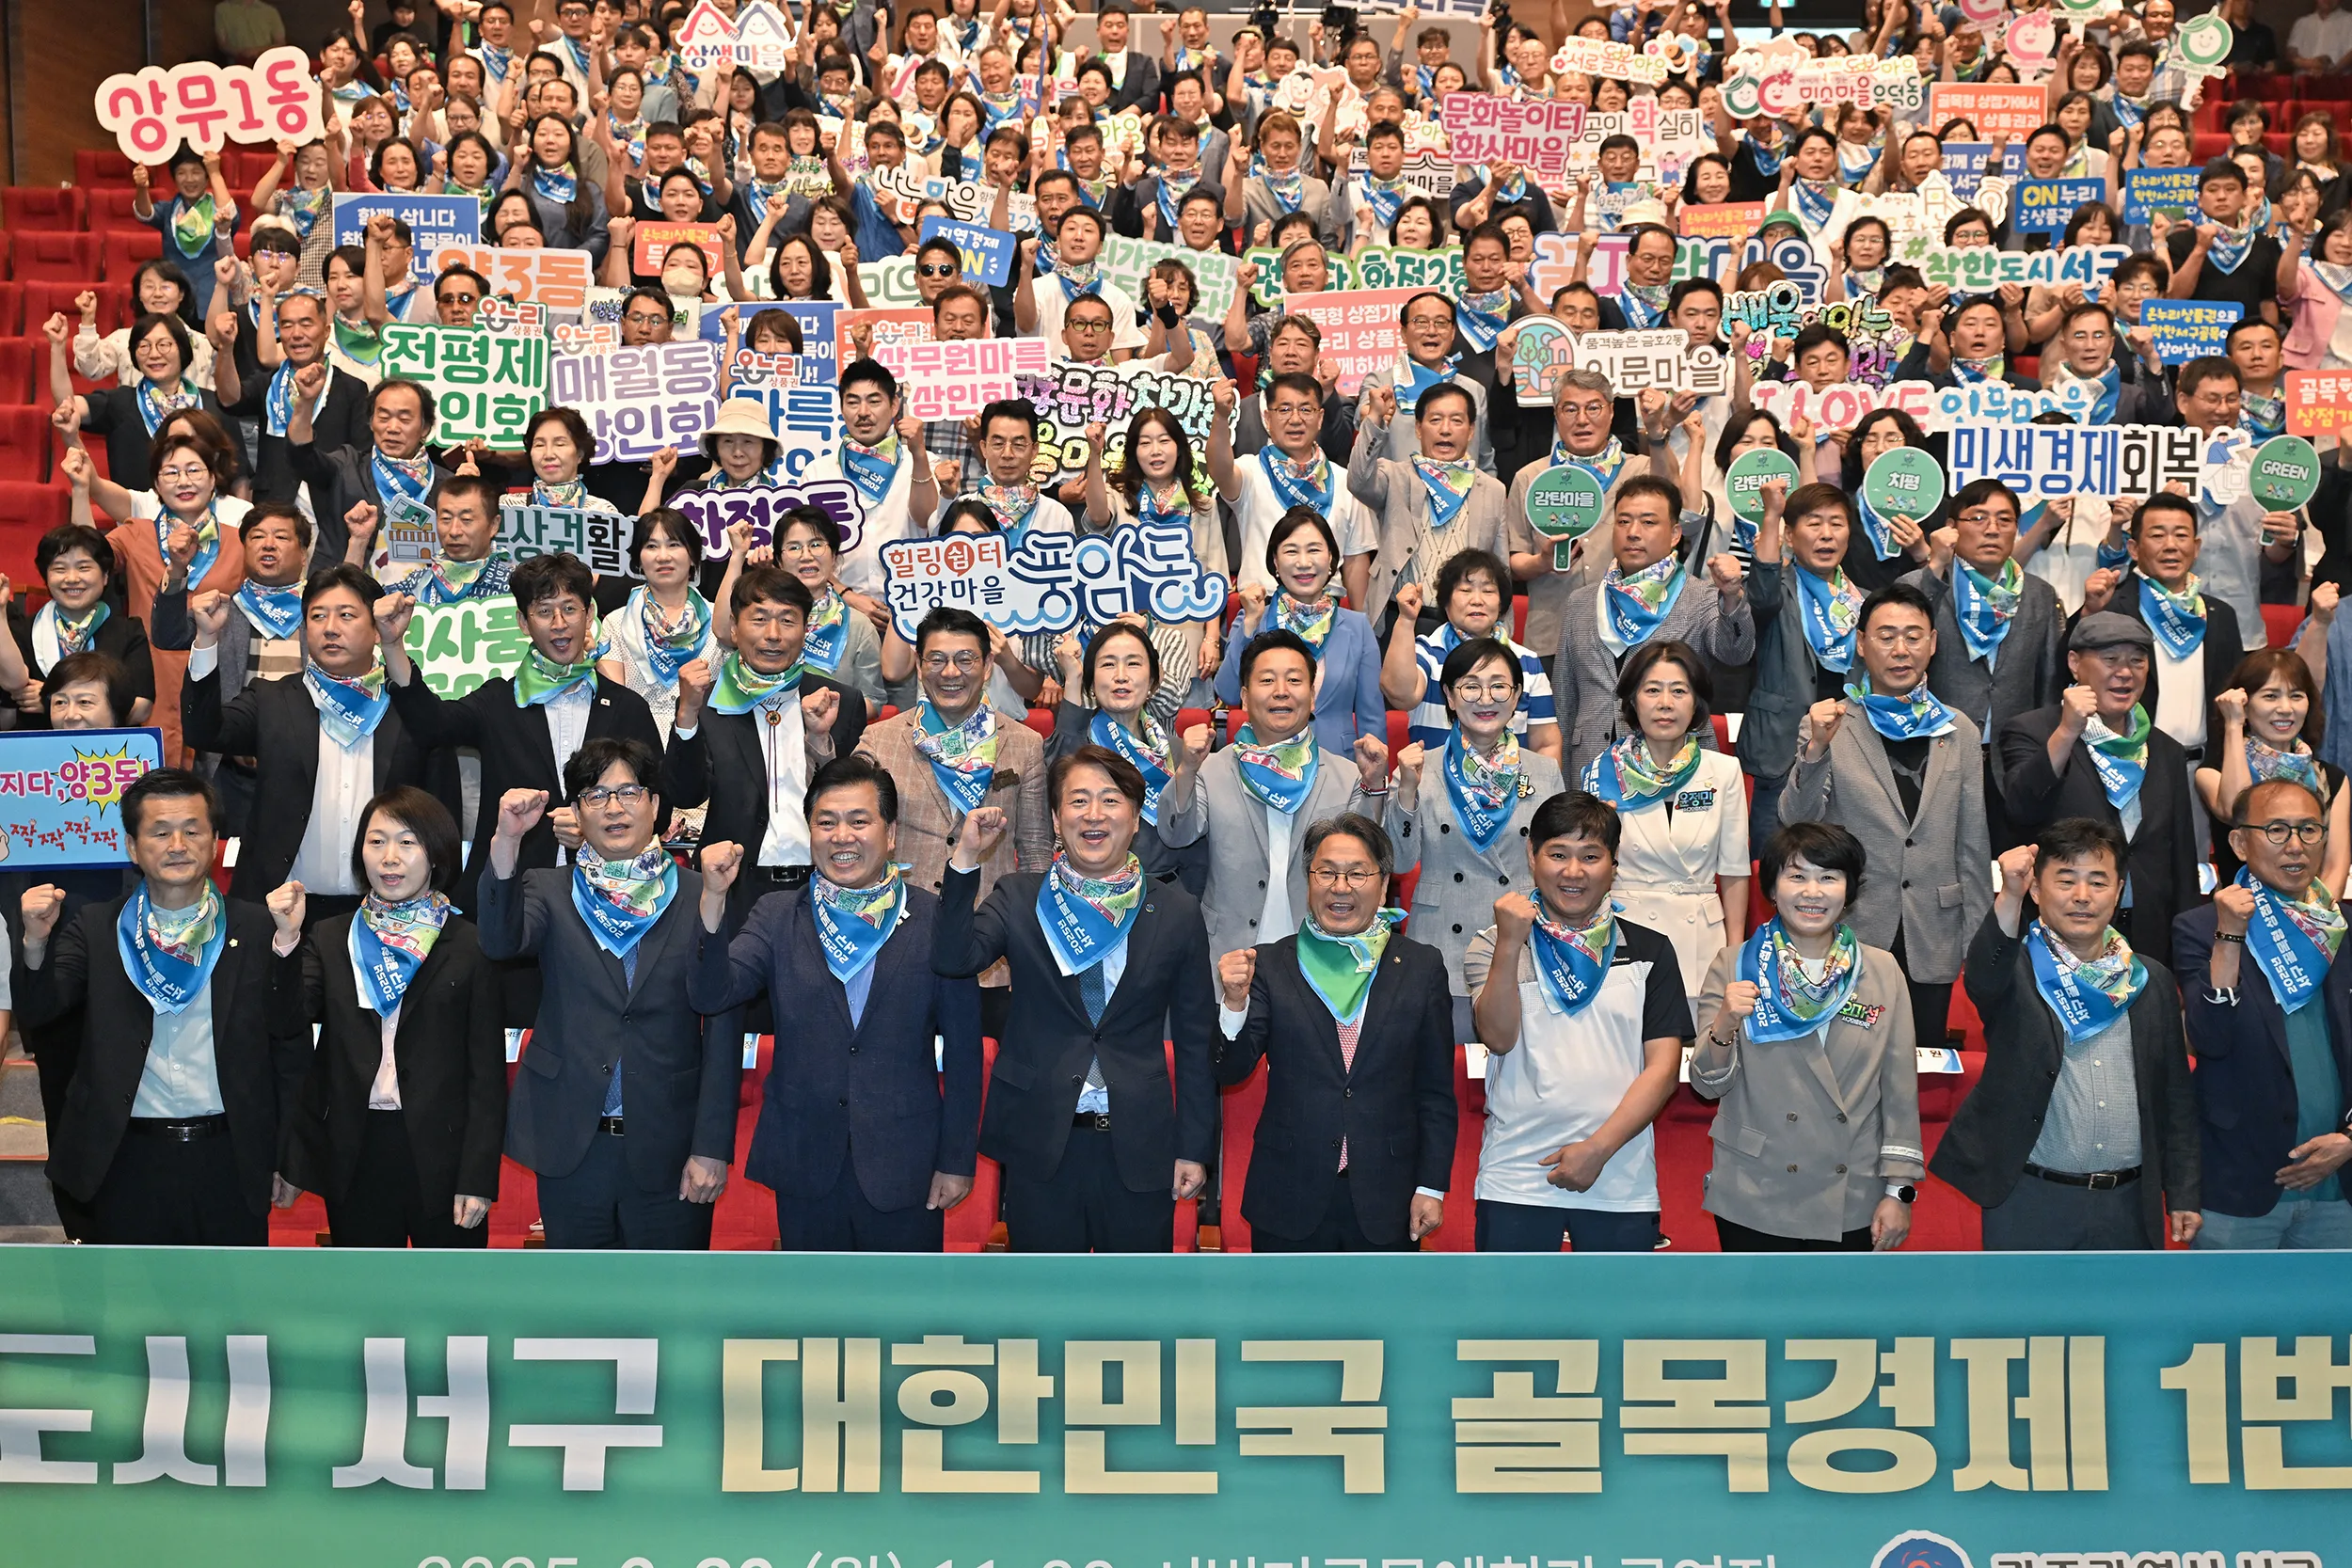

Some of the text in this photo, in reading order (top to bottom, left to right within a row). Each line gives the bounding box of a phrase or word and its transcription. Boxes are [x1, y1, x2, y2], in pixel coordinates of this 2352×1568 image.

[685, 44, 783, 68] 상생마을
[109, 59, 309, 152] 상무1동
[1443, 96, 1582, 139] 문화놀이터
[1454, 131, 1565, 170] 화사마을
[400, 209, 456, 228] 삽니다
[937, 224, 1000, 249] 지역경제
[476, 298, 544, 333] 온누리
[511, 325, 543, 337] 상품권
[551, 324, 618, 356] 온누리
[587, 342, 618, 356] 상품권
[874, 319, 921, 346] 온누리
[1585, 333, 1684, 351] 품격높은 금호2동
[386, 330, 543, 388] 전평제
[553, 346, 714, 404] 매월동
[733, 351, 801, 385] 온누리
[877, 341, 1047, 379] 상무원마륵
[1586, 351, 1722, 390] 인문마을
[769, 376, 799, 388] 상품권
[437, 391, 541, 442] 인회
[1790, 387, 1931, 432] LOVE
[1952, 426, 2200, 497] 민생경제회복
[2260, 458, 2310, 482] GREEN
[1887, 471, 1921, 491] 치평
[1534, 490, 1596, 508] 감탄마을
[894, 575, 1006, 611] 건강마을
[1677, 790, 1715, 808] 윤정민
[818, 930, 850, 964] 2025년
[834, 935, 860, 956] 서구
[1057, 919, 1084, 956] 2025년
[1072, 923, 1096, 951] 서구
[2270, 927, 2298, 965] 골목형
[162, 982, 186, 1001] 서구
[373, 963, 397, 1002] 2025년
[389, 973, 408, 995] 서구
[1552, 968, 1577, 1000] 2025년
[1567, 973, 1588, 994] 서구
[2270, 956, 2298, 995] 2025년
[2289, 964, 2312, 989] 서구
[2052, 989, 2079, 1026] 2025년
[2057, 963, 2090, 1022] 서구 골목형
[1766, 1001, 1783, 1025] 서구
[330, 1334, 664, 1493] 서구
[721, 1334, 1389, 1497] 대한민국
[1451, 1335, 2110, 1496] 골목경제
